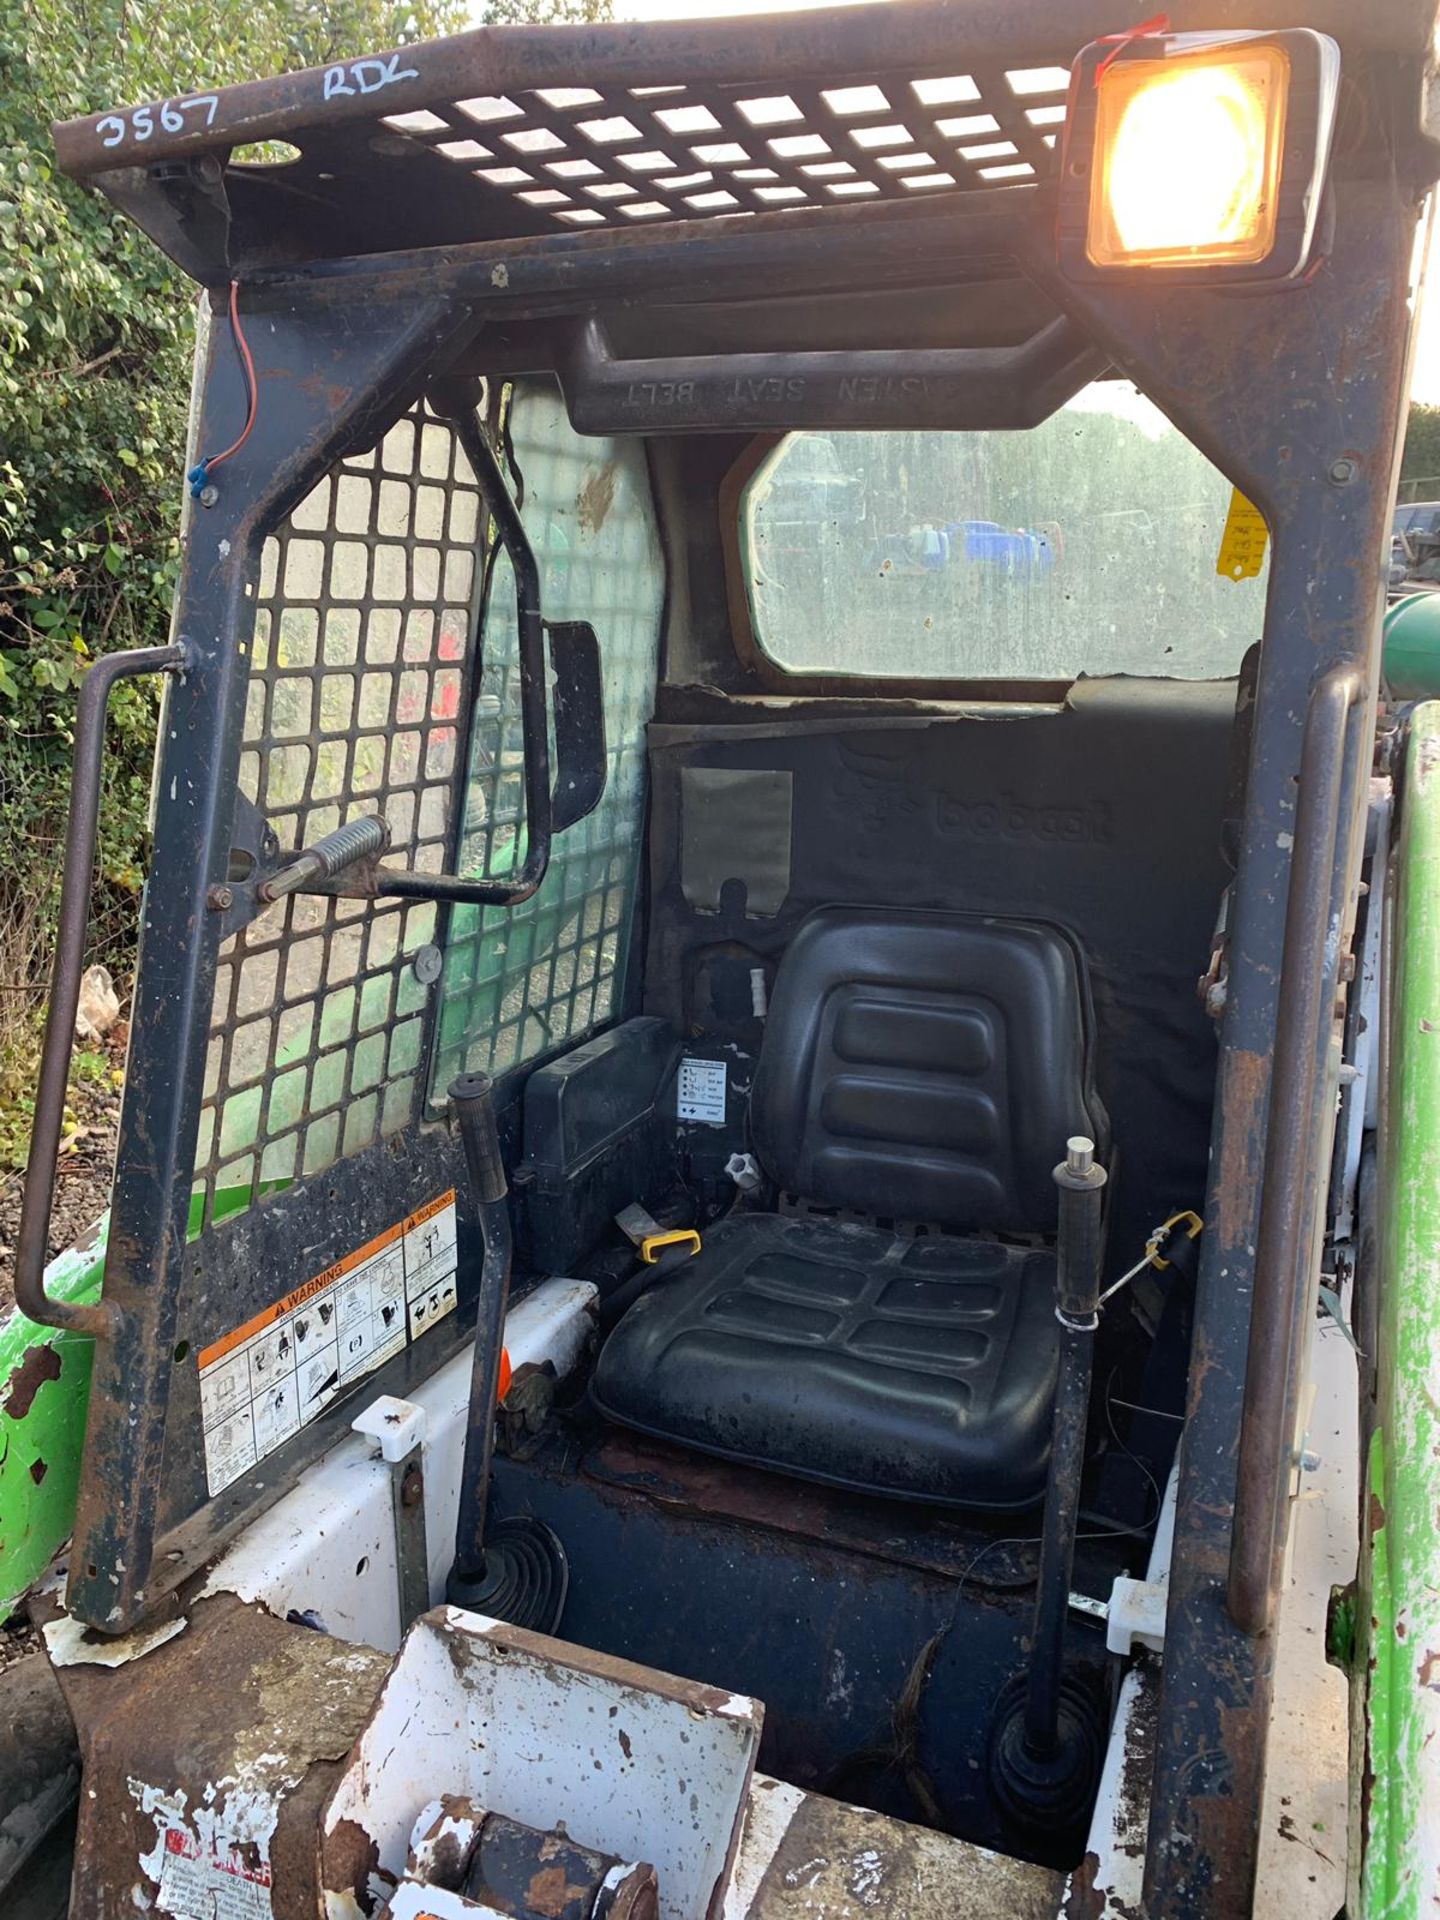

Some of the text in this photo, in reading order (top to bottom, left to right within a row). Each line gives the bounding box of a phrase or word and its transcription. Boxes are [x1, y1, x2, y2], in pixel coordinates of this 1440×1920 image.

[626, 381, 694, 407] BELT
[727, 377, 806, 404] SEAT
[417, 1192, 452, 1221] WARNING
[288, 1263, 343, 1307] WARNING
